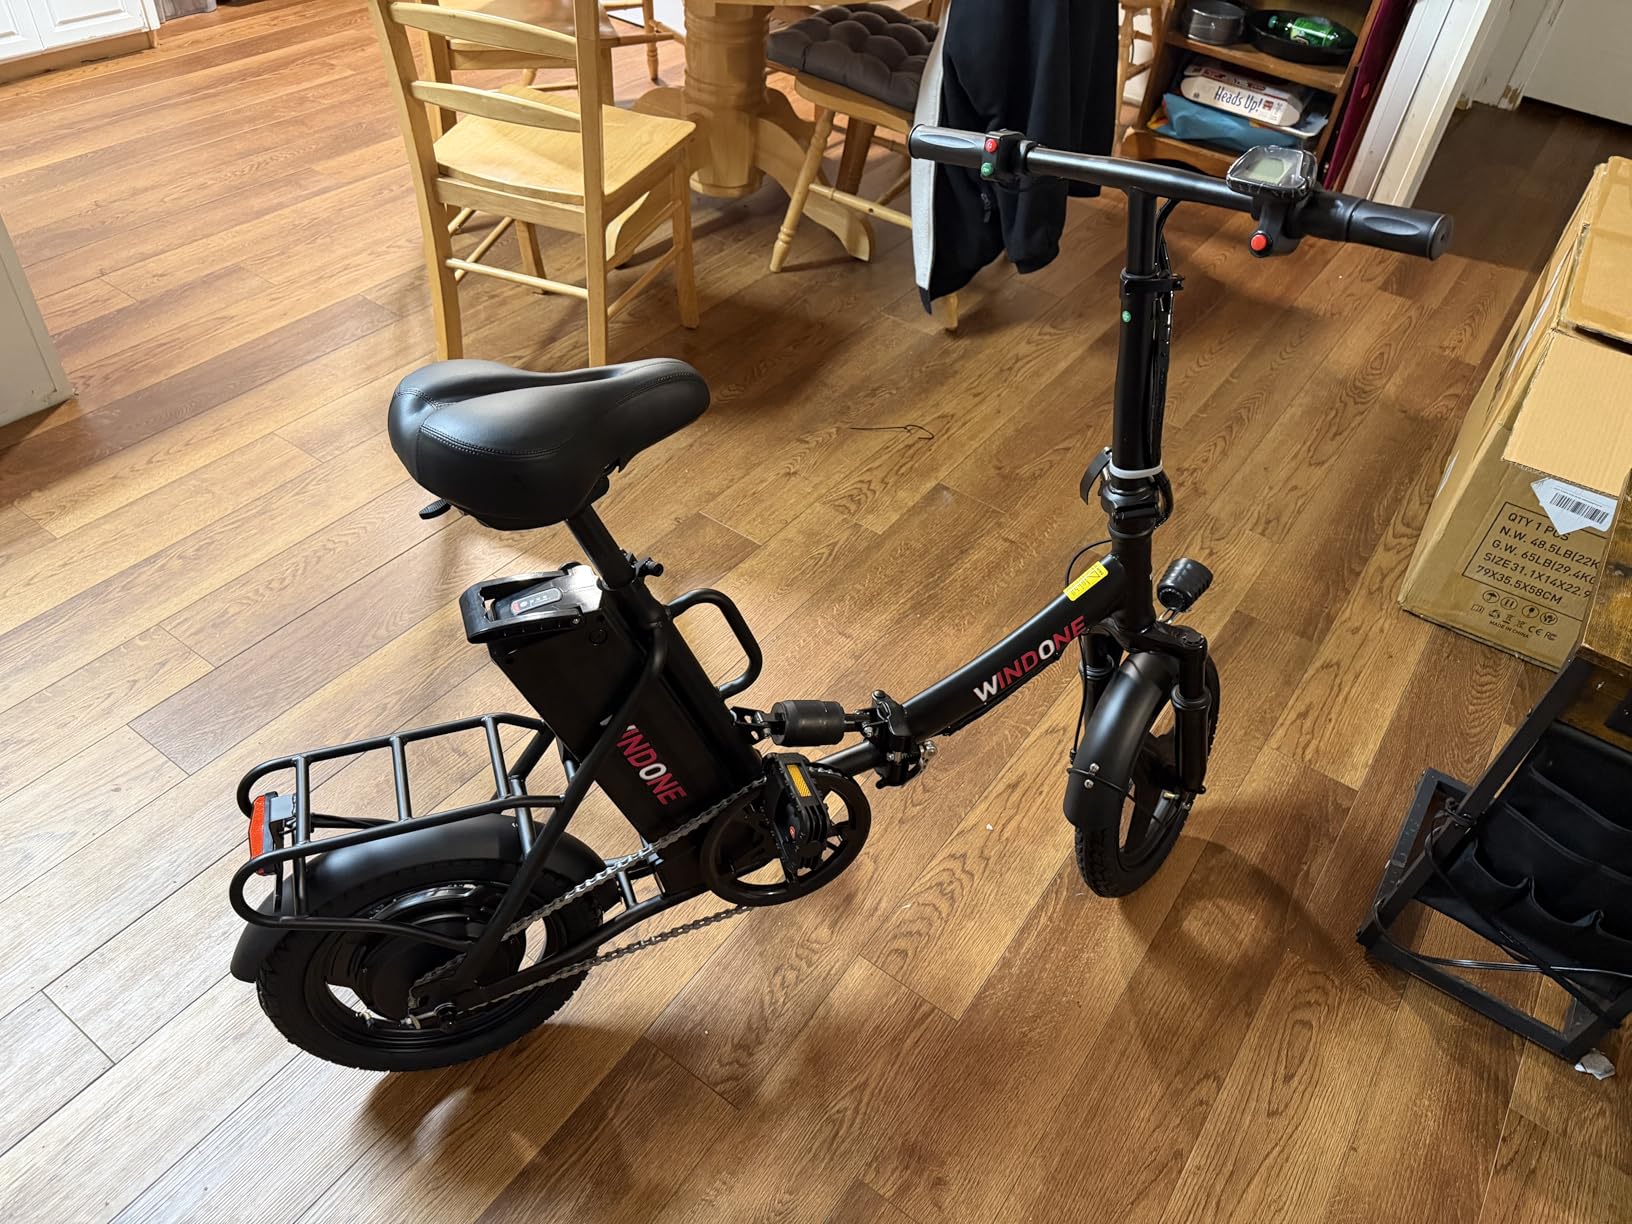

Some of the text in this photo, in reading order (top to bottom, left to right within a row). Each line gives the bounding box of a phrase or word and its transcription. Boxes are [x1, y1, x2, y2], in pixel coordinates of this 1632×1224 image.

[1214, 85, 1242, 107] Heads
[1244, 94, 1264, 113] Up!
[1500, 526, 1527, 543] N.W.
[1508, 512, 1533, 527] QTY
[1535, 522, 1542, 531] 1
[1492, 539, 1517, 556] G.W.
[1476, 565, 1563, 605] 79X35.5X58CM
[973, 615, 1087, 703] WINDONE
[600, 714, 687, 805] INDONE
